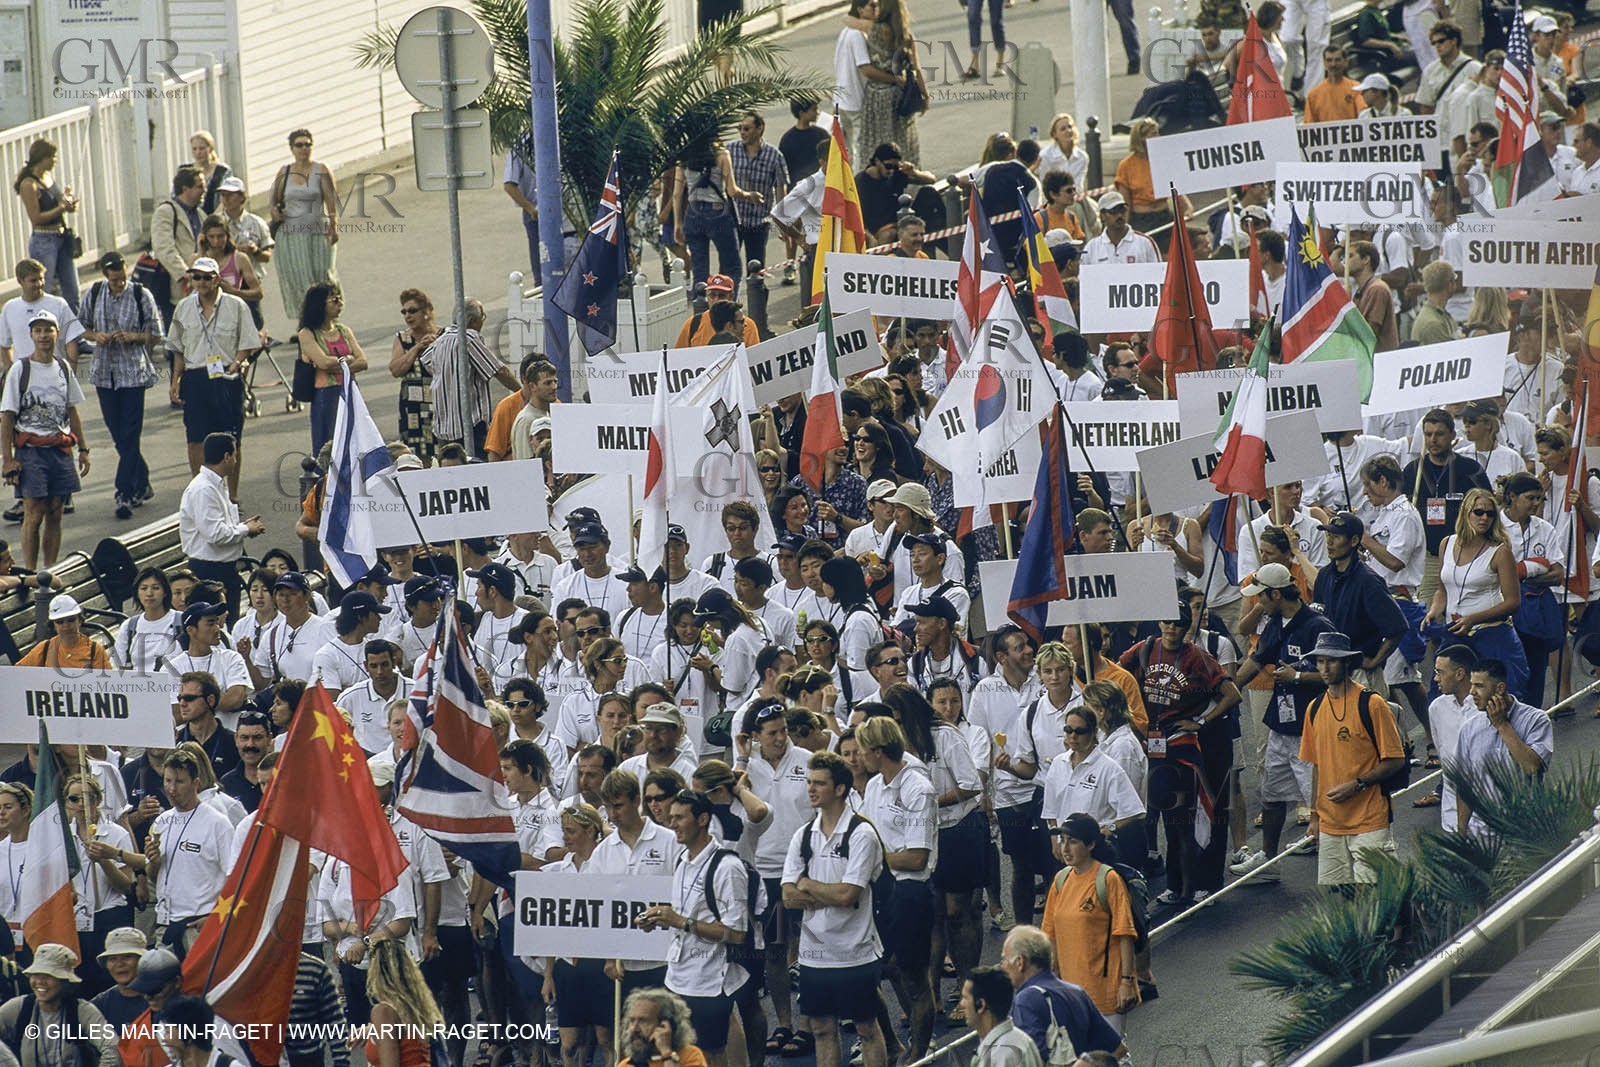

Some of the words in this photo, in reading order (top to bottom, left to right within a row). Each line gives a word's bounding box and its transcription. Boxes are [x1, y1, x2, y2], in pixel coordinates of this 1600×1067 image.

[1297, 124, 1363, 148] UNITED
[1369, 119, 1437, 142] STATES
[1184, 140, 1265, 171] TUNISIA
[1311, 150, 1333, 162] OF
[1339, 143, 1426, 162] AMERICA
[1283, 180, 1413, 202] SWITZERLAND
[1469, 240, 1540, 264] SOUTH
[843, 272, 958, 301] SEYCHELLES
[1108, 281, 1220, 308] MORO
[776, 329, 868, 376] ZEAND
[1398, 357, 1472, 390] POLAND
[1217, 384, 1322, 416] NIBIA
[984, 449, 1019, 478] OREA
[1191, 441, 1276, 481] LAA
[418, 486, 491, 518] JAPAN
[25, 689, 129, 720] IRELAND
[520, 896, 604, 928] GREAT
